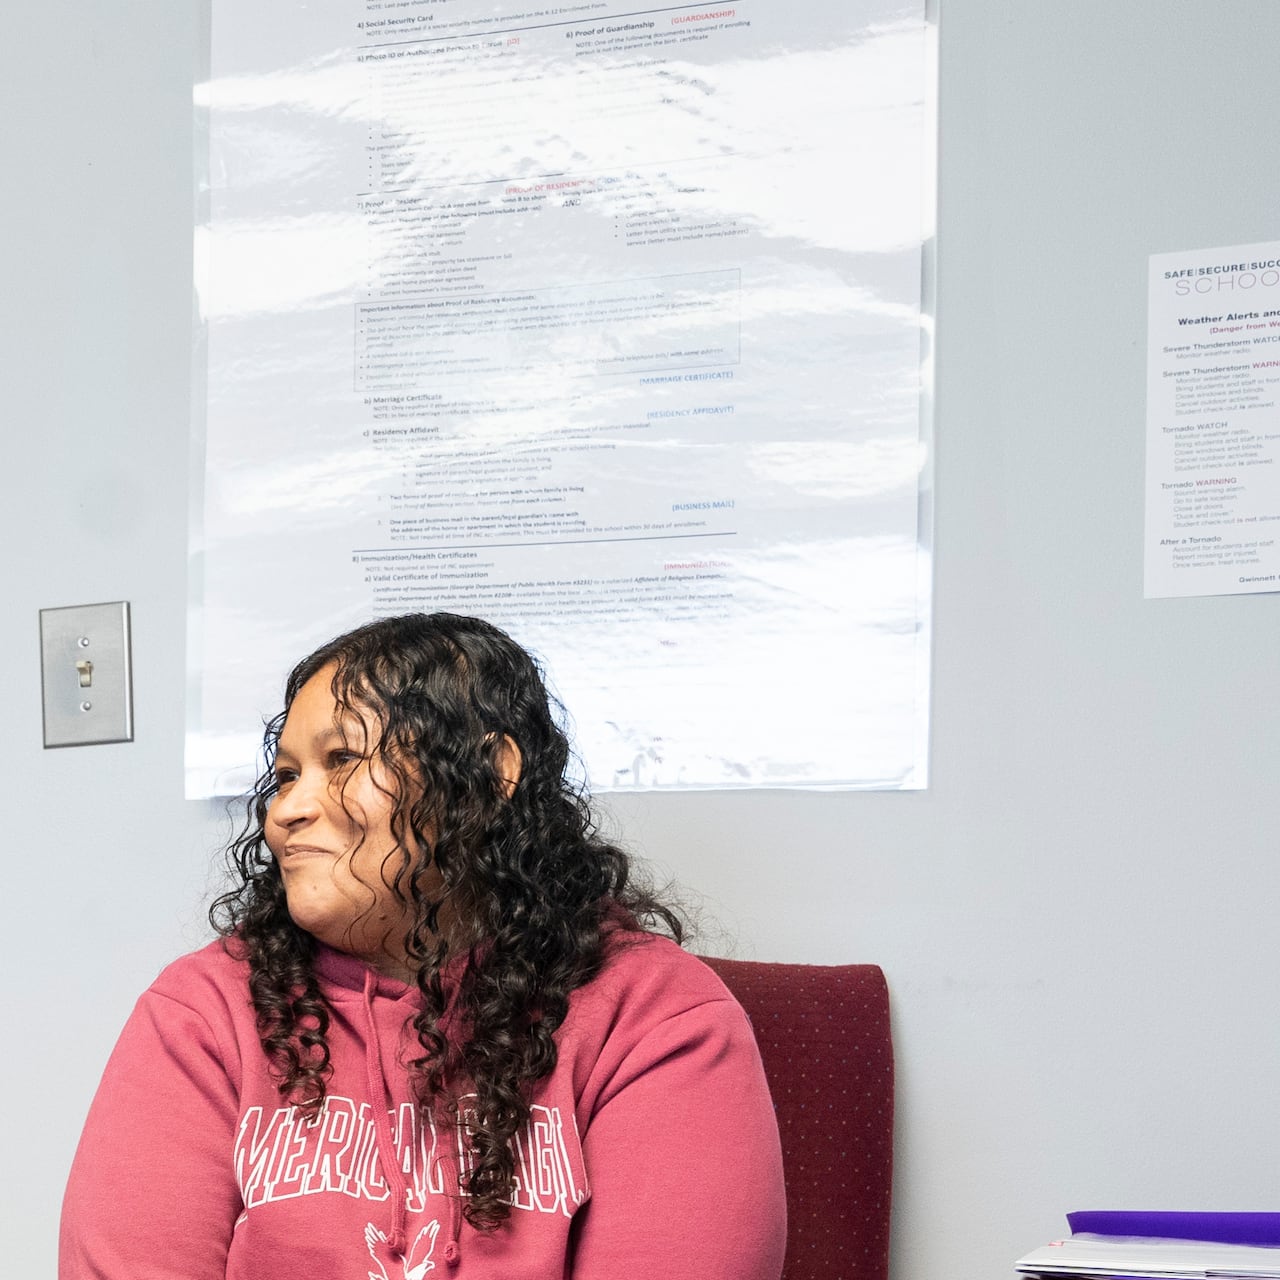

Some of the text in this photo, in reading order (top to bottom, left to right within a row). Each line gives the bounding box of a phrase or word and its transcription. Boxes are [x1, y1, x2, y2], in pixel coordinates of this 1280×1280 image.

[365, 19, 386, 28] Social
[387, 17, 414, 27] Security
[500, 13, 524, 23] provided
[671, 9, 735, 25] (GUARDIANSHIP)
[606, 21, 654, 33] Guardianship
[1178, 316, 1223, 326] Weather
[1226, 312, 1259, 321] Alerts
[1210, 325, 1243, 335] (Danger
[1194, 340, 1251, 349] Thunderstorm
[1193, 365, 1250, 373] Thunderstorm
[684, 371, 734, 382] CERTIFICATE)
[373, 395, 404, 404] Marriage
[406, 393, 442, 401] Certificate
[647, 405, 734, 419] (RESIDENCY AFFIDAVIT)
[373, 428, 407, 436] Residency
[409, 426, 439, 434] Affidavit
[1162, 421, 1228, 433] Tornado WATCH
[1161, 477, 1237, 489] Tornado WARNING
[672, 500, 735, 512] (BUSINESS MAIL)
[1189, 536, 1222, 544] Tornado
[361, 552, 436, 562] Immunization/Health
[392, 573, 429, 581] Certificate
[439, 571, 488, 580] Immunization
[1239, 575, 1275, 583] Gwinnett
